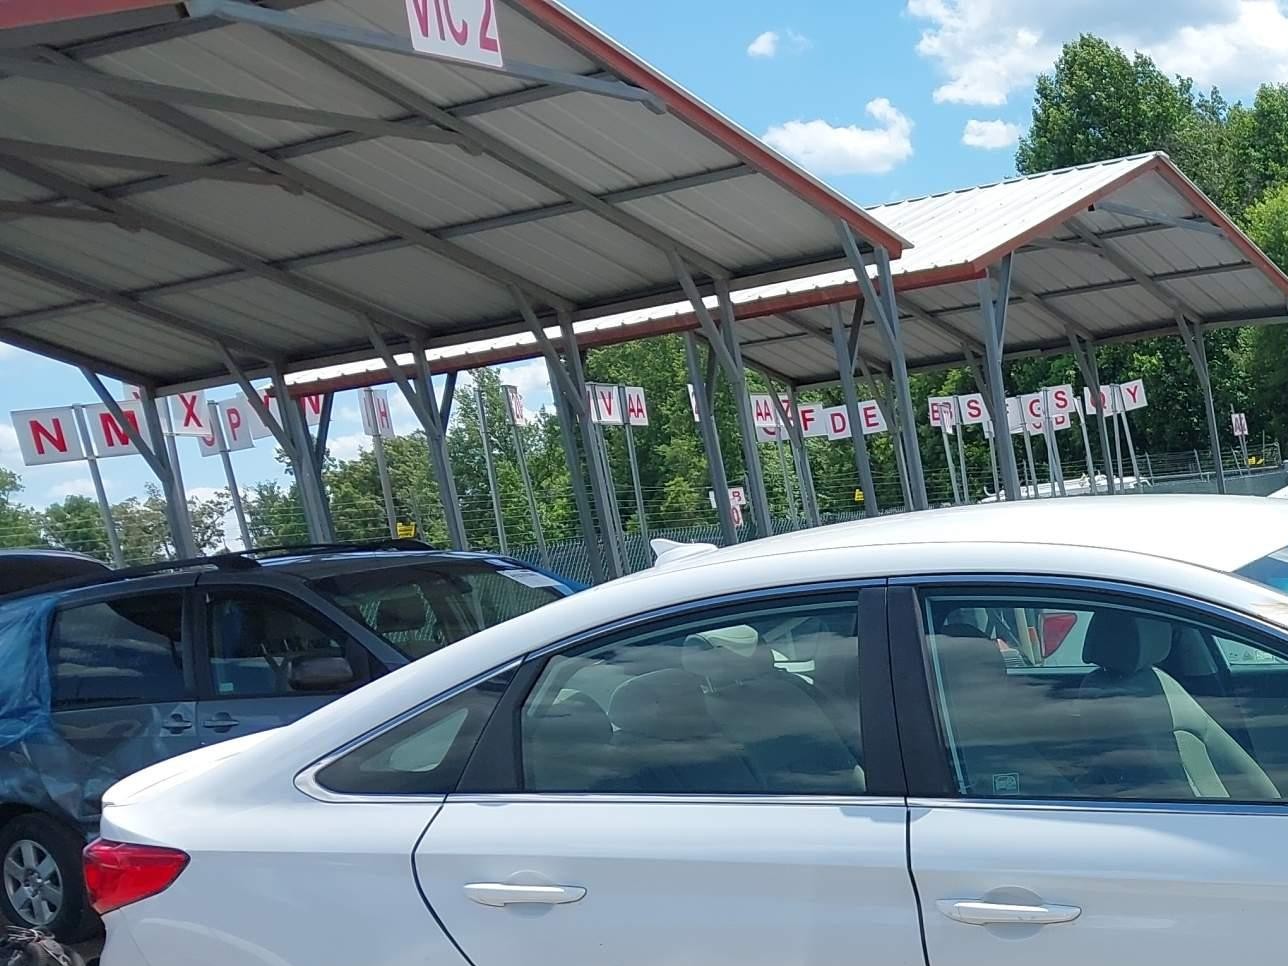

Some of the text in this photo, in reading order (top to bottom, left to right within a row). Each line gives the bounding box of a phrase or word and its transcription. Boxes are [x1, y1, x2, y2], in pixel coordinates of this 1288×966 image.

[628, 393, 646, 418] AA
[1054, 390, 1068, 409] S
[1126, 385, 1138, 404] Y
[178, 394, 203, 428] X
[376, 398, 391, 430] H
[756, 399, 773, 421] AA
[863, 406, 880, 427] E
[966, 399, 982, 418] S
[99, 410, 140, 447] M
[226, 407, 241, 441] P
[801, 409, 815, 432] F
[830, 412, 847, 434] D
[29, 418, 68, 455] N
